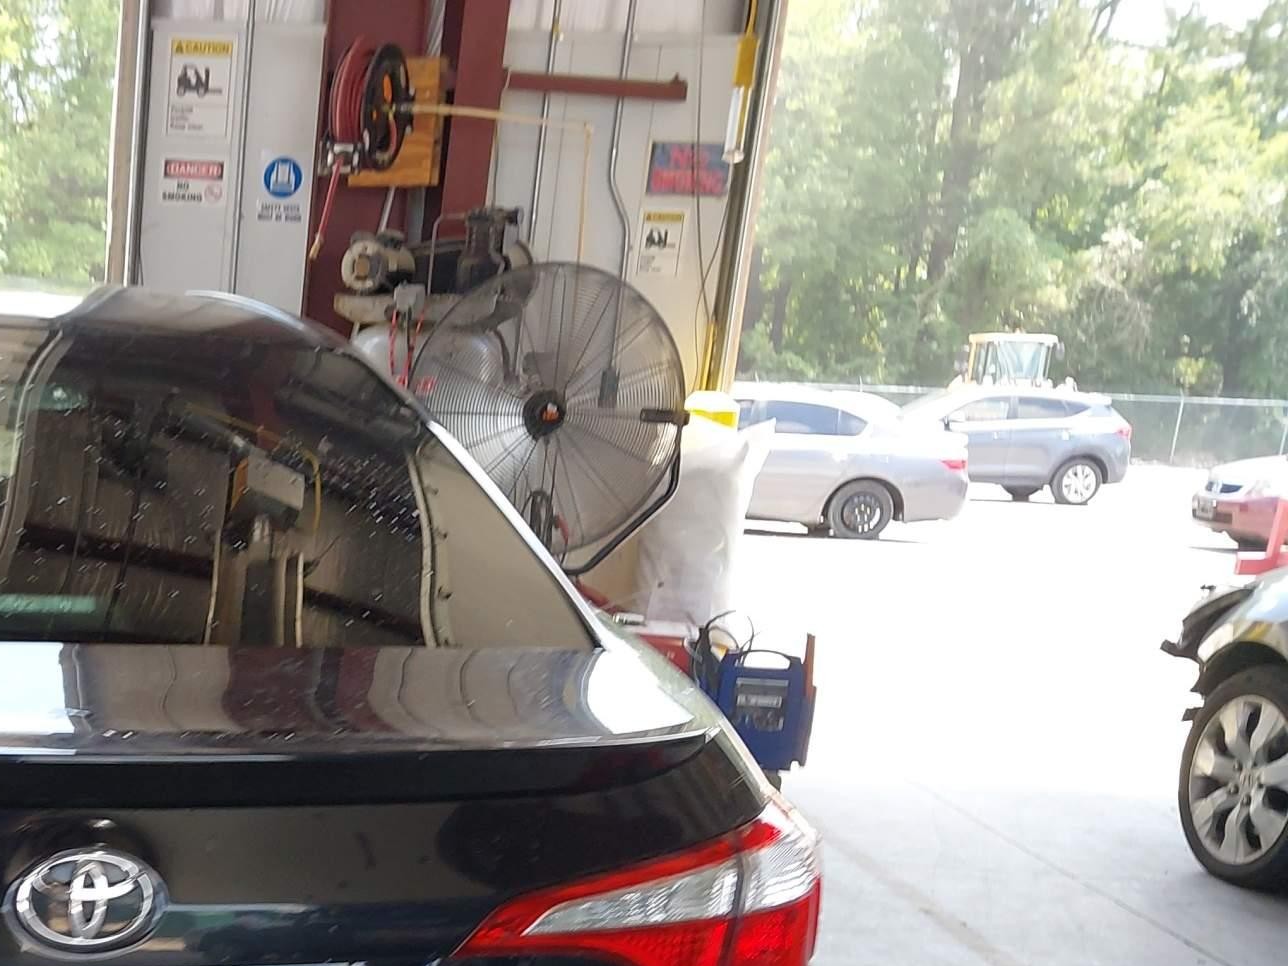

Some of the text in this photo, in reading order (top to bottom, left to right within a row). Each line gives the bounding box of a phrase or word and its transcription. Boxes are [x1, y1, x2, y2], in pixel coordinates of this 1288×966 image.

[185, 41, 231, 54] CAUTION
[170, 162, 219, 176] DANGER
[176, 181, 190, 191] NO
[162, 191, 202, 202] SMOKING
